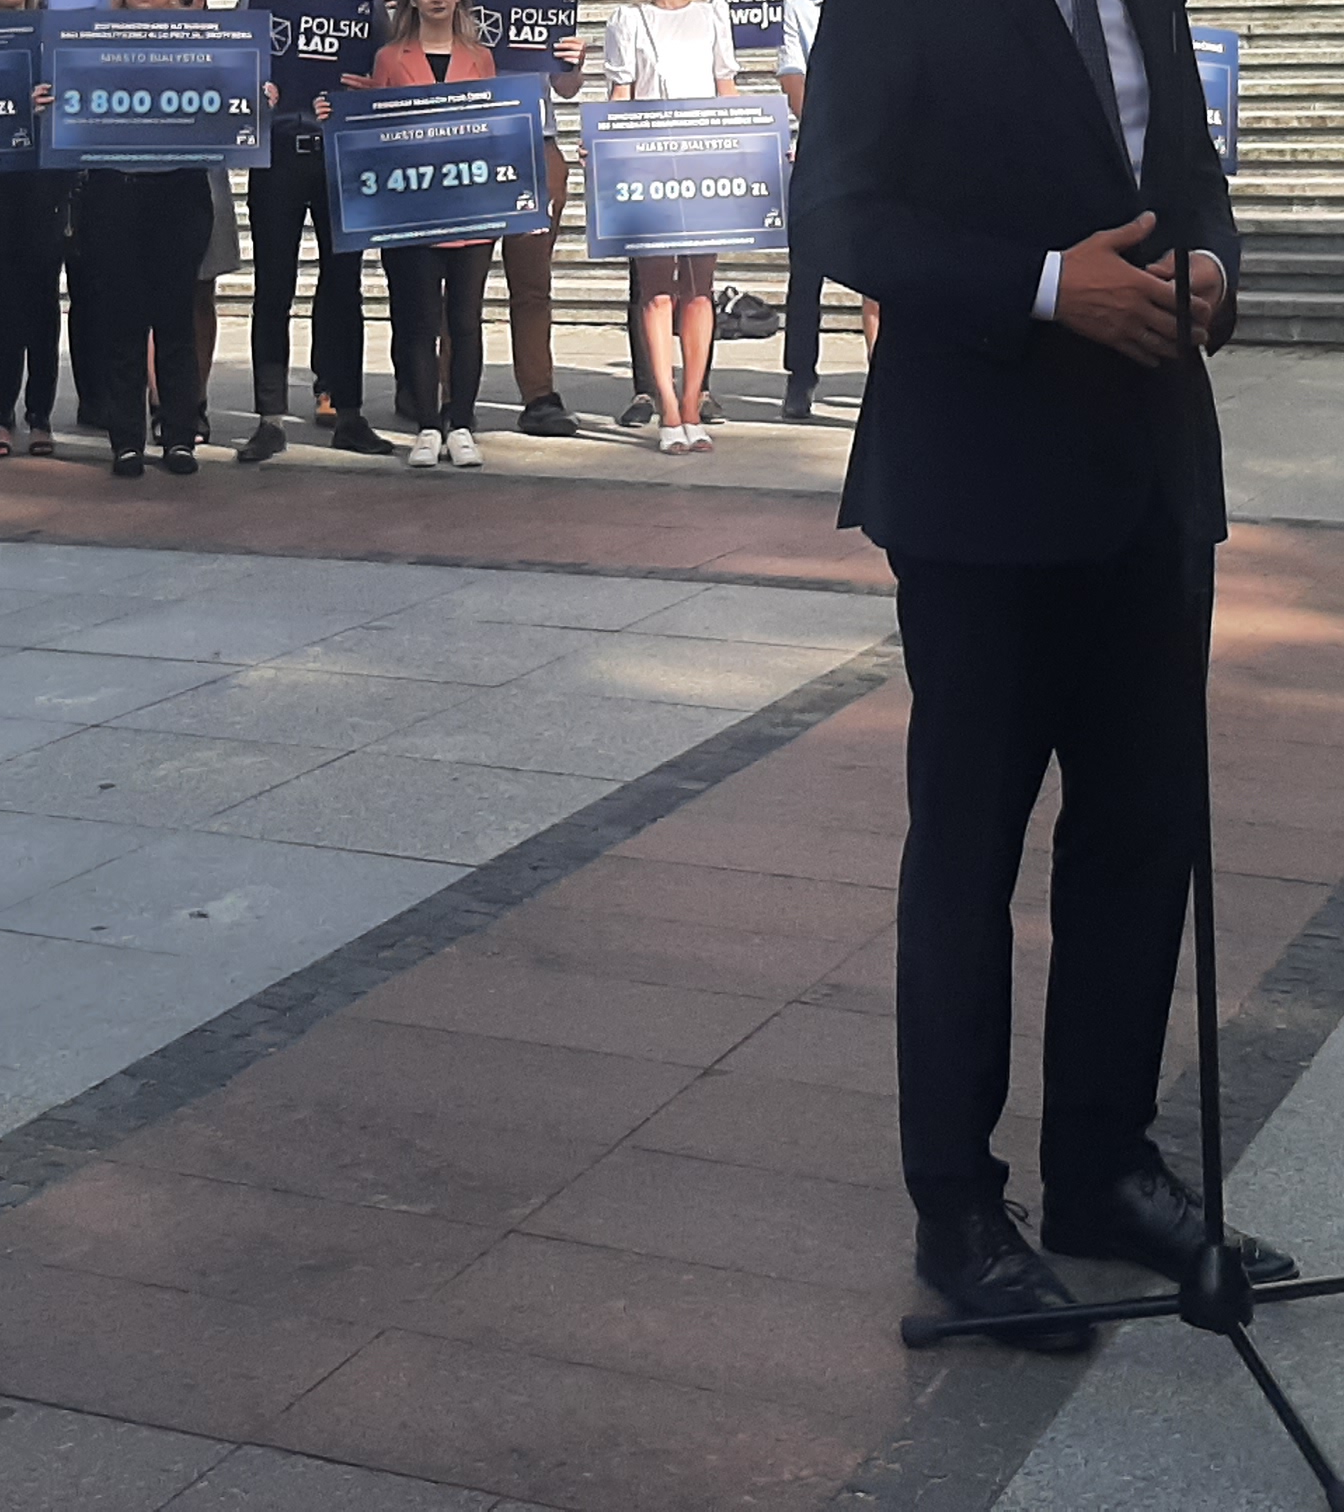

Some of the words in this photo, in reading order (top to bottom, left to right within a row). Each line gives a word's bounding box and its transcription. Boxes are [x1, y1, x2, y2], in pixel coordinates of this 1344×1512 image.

[299, 16, 369, 39] POLSKI
[510, 8, 576, 26] POLSKI
[729, 2, 783, 30] woju
[297, 35, 340, 53] ŁAD
[508, 24, 549, 42] ŁAD
[63, 89, 82, 114] 3
[90, 89, 153, 115] 800
[160, 89, 222, 115] 000
[360, 171, 378, 195] 3
[387, 165, 435, 192] 417
[441, 160, 489, 187] 219
[615, 182, 645, 202] 32
[649, 178, 696, 201] 000
[701, 176, 747, 199] 000
